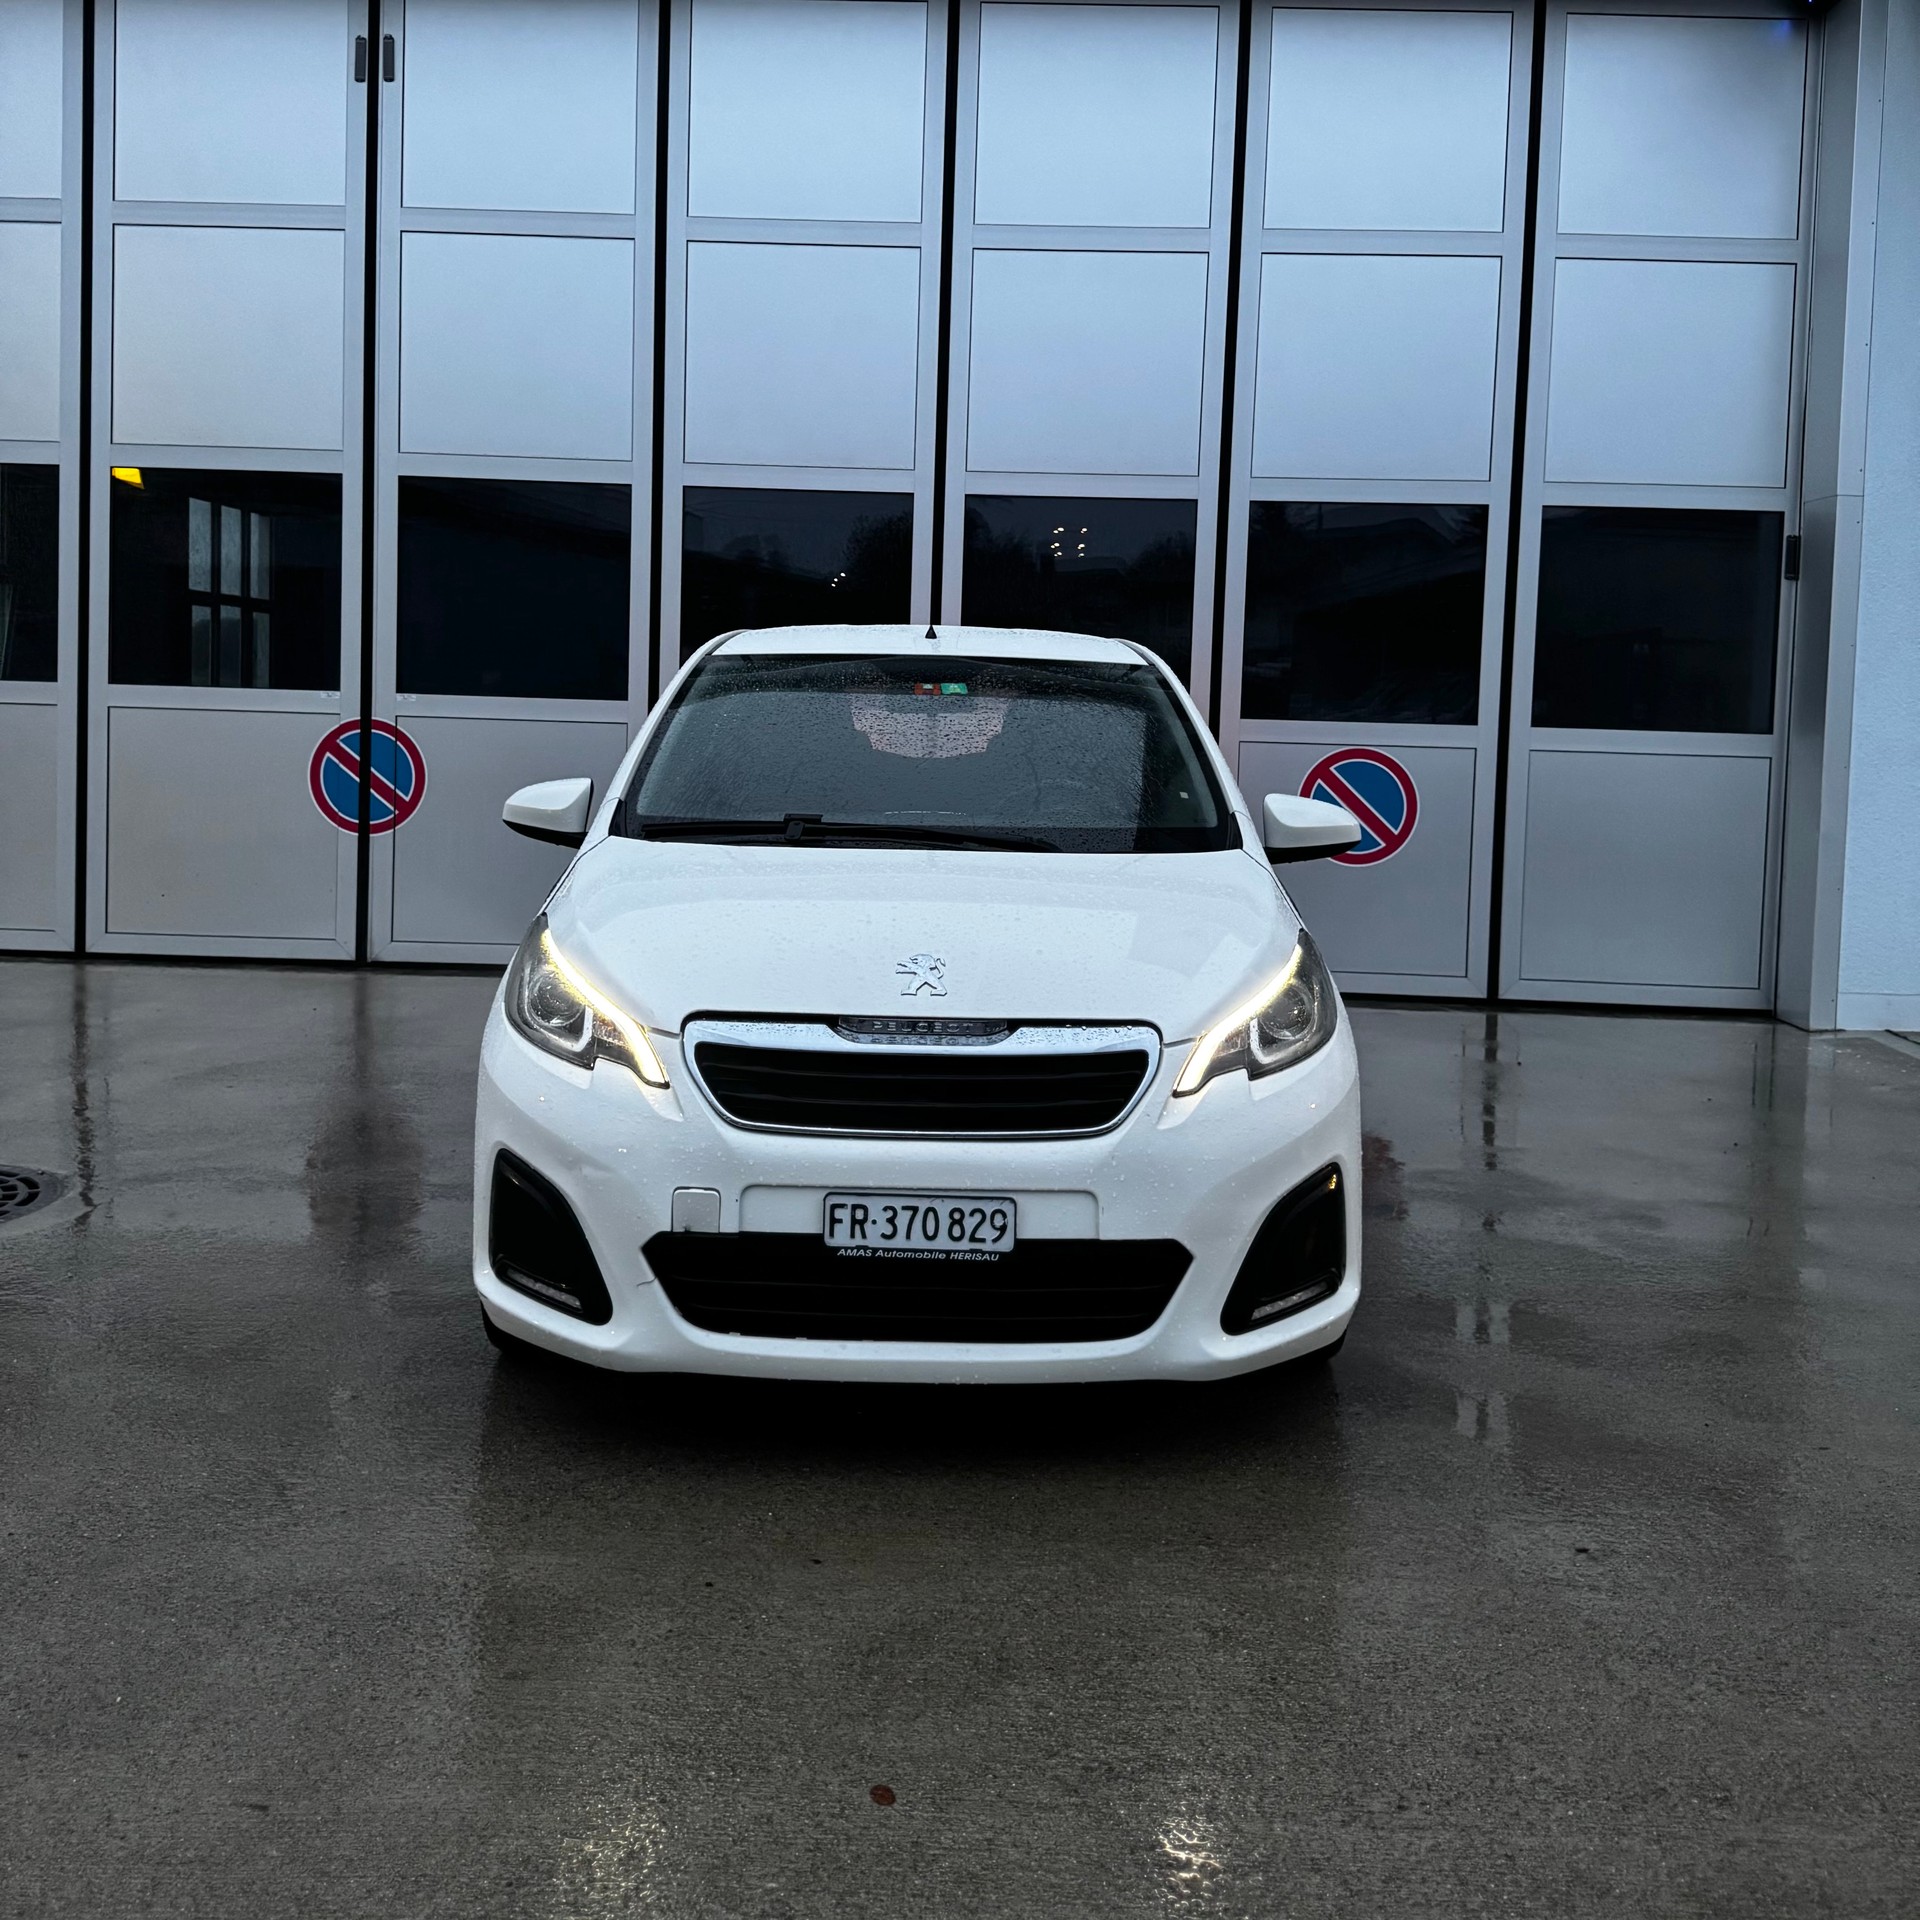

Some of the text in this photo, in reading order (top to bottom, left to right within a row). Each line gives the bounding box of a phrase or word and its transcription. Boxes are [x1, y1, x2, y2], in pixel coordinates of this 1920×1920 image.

[872, 1021, 974, 1033] PEUGEOT
[837, 1248, 1000, 1261] AMAS Automobile HERISAU
